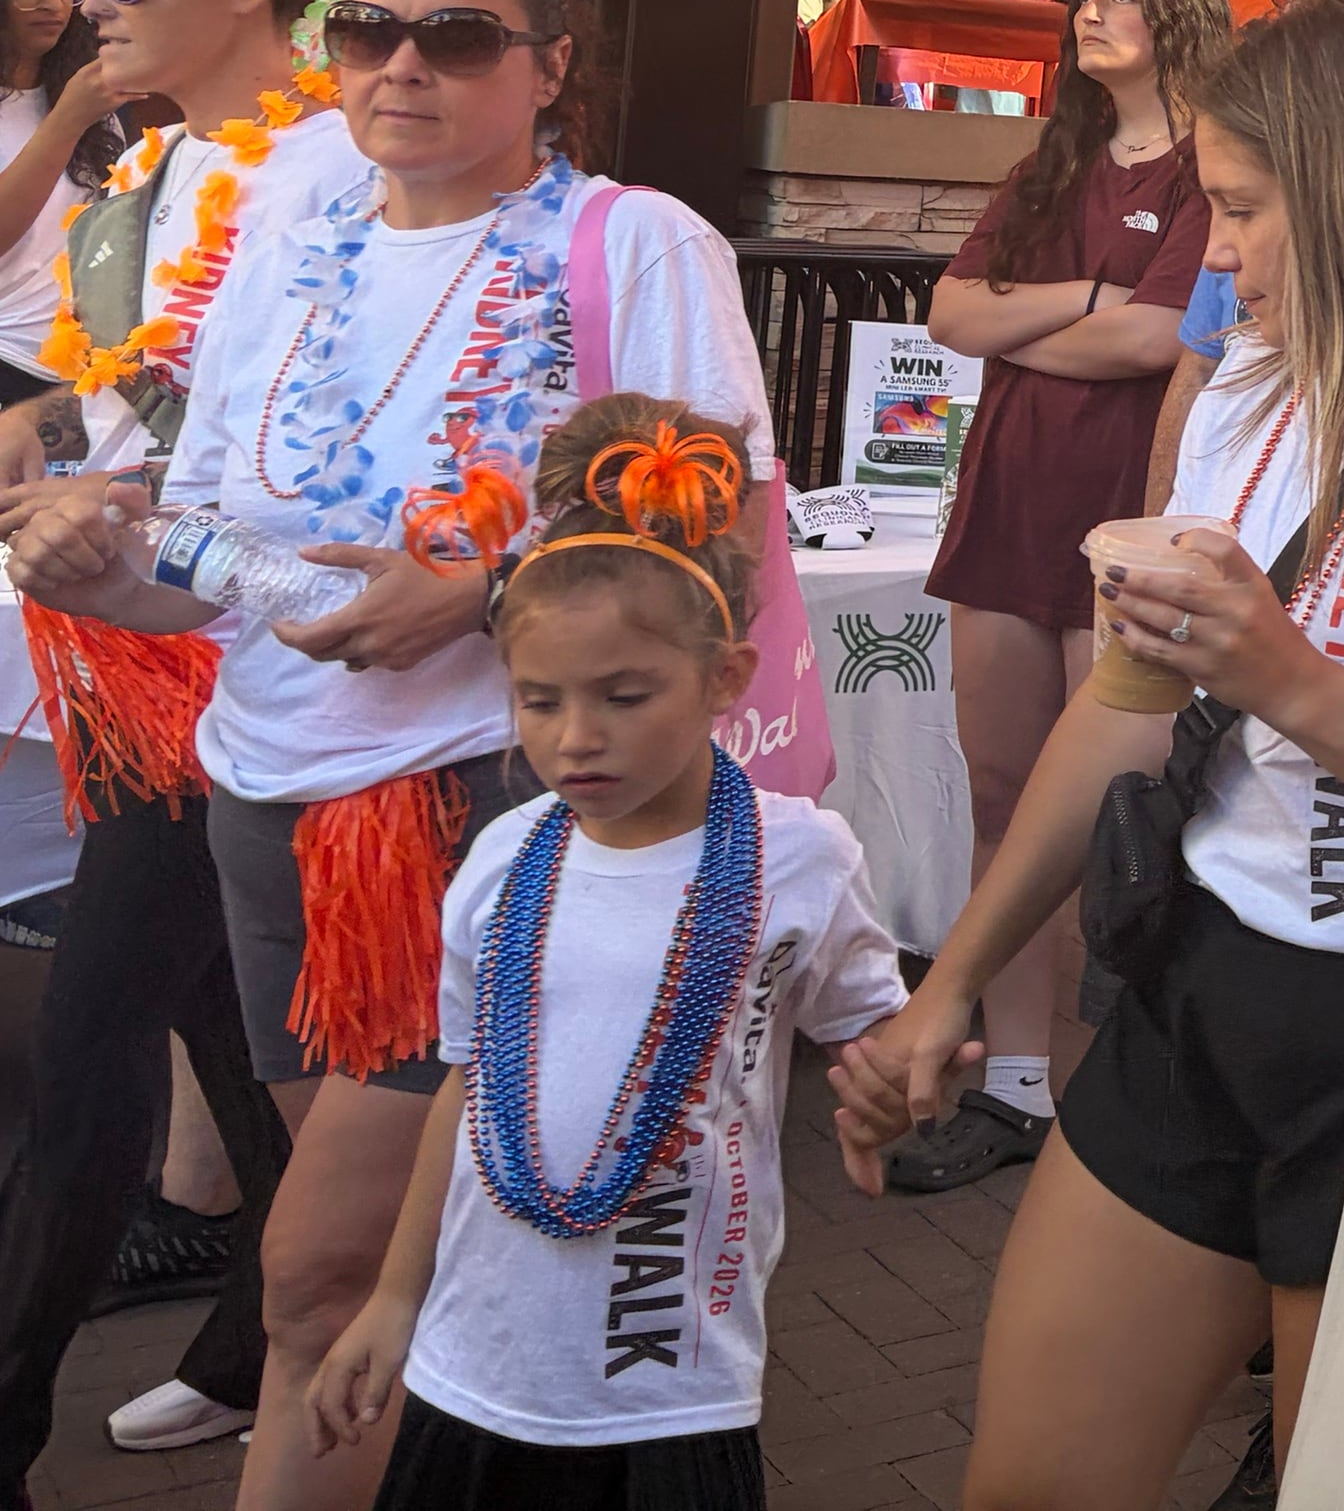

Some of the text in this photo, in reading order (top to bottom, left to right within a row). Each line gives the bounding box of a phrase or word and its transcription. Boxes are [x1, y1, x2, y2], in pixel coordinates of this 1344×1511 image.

[880, 375, 888, 383] A
[890, 375, 936, 386] SAMSUNG
[890, 356, 943, 377] WIN
[724, 1121, 750, 1245] OCTOBER
[604, 1183, 694, 1380] WALK
[709, 1252, 744, 1316] 2026
